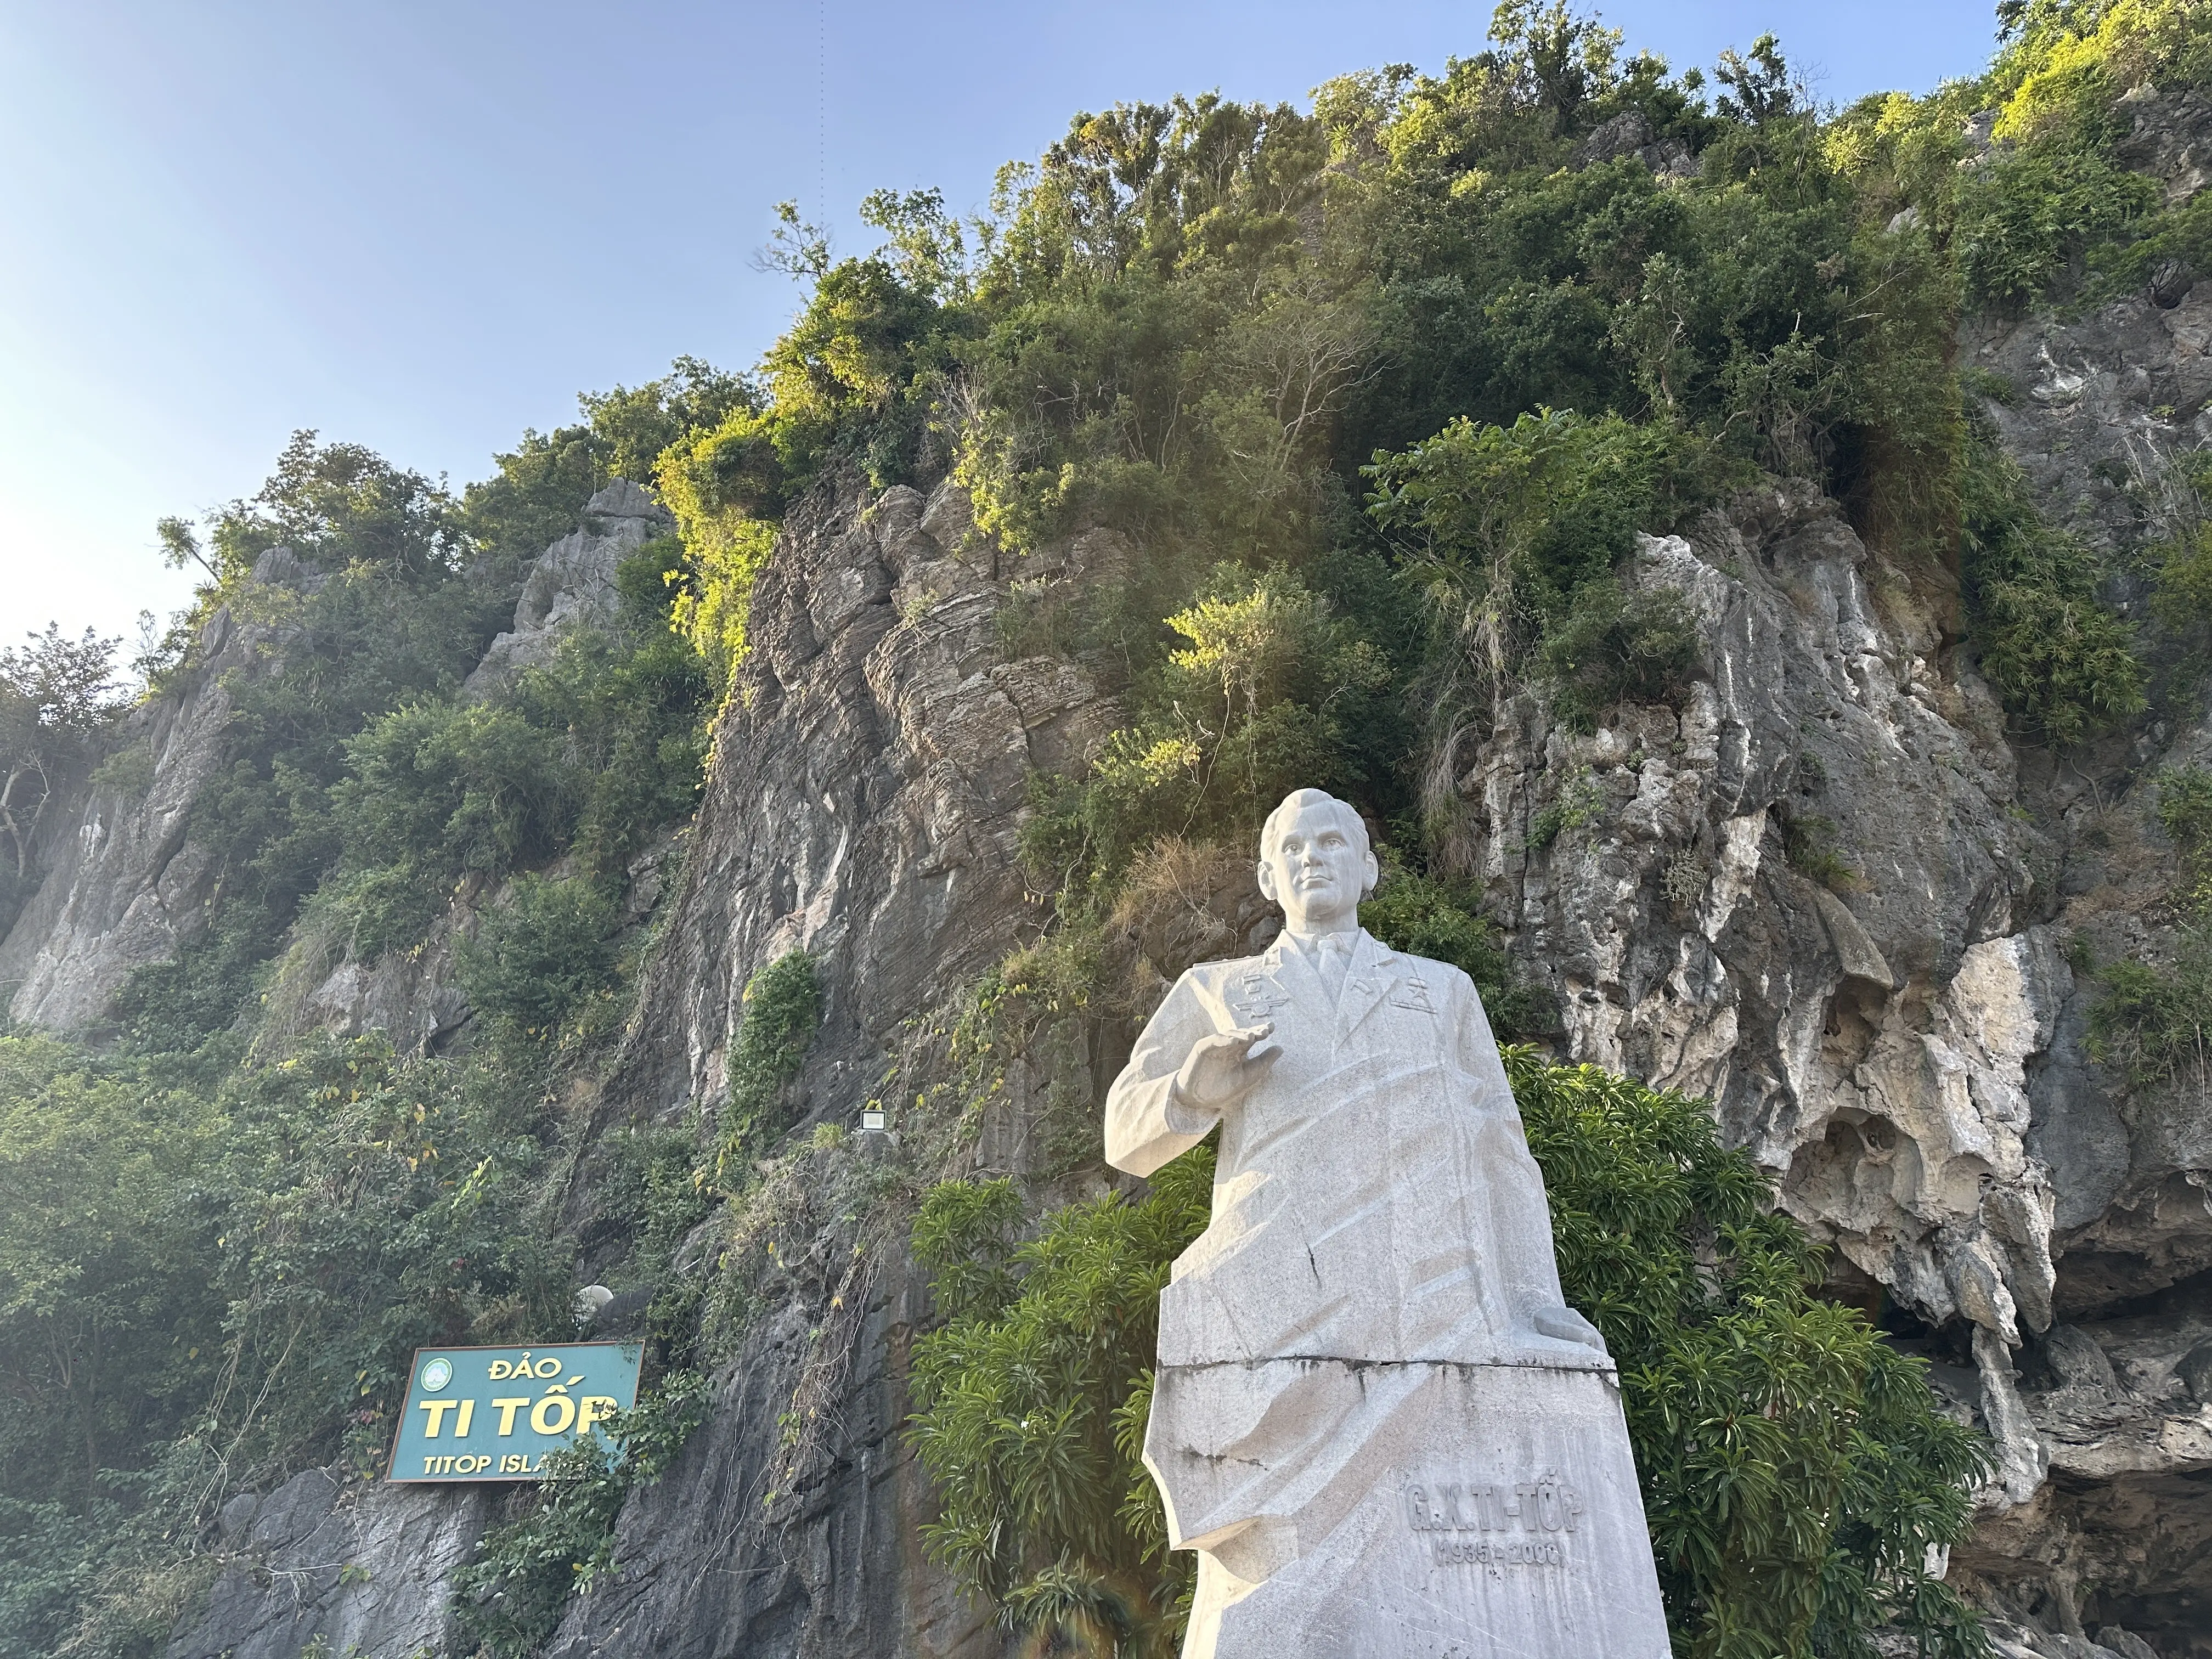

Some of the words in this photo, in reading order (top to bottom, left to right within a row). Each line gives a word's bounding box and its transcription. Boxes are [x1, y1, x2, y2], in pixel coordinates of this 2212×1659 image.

[488, 1351, 562, 1380] ĐẢO
[419, 1399, 475, 1438] TI
[491, 1375, 618, 1436] TỐP
[423, 1455, 492, 1474] TITOP
